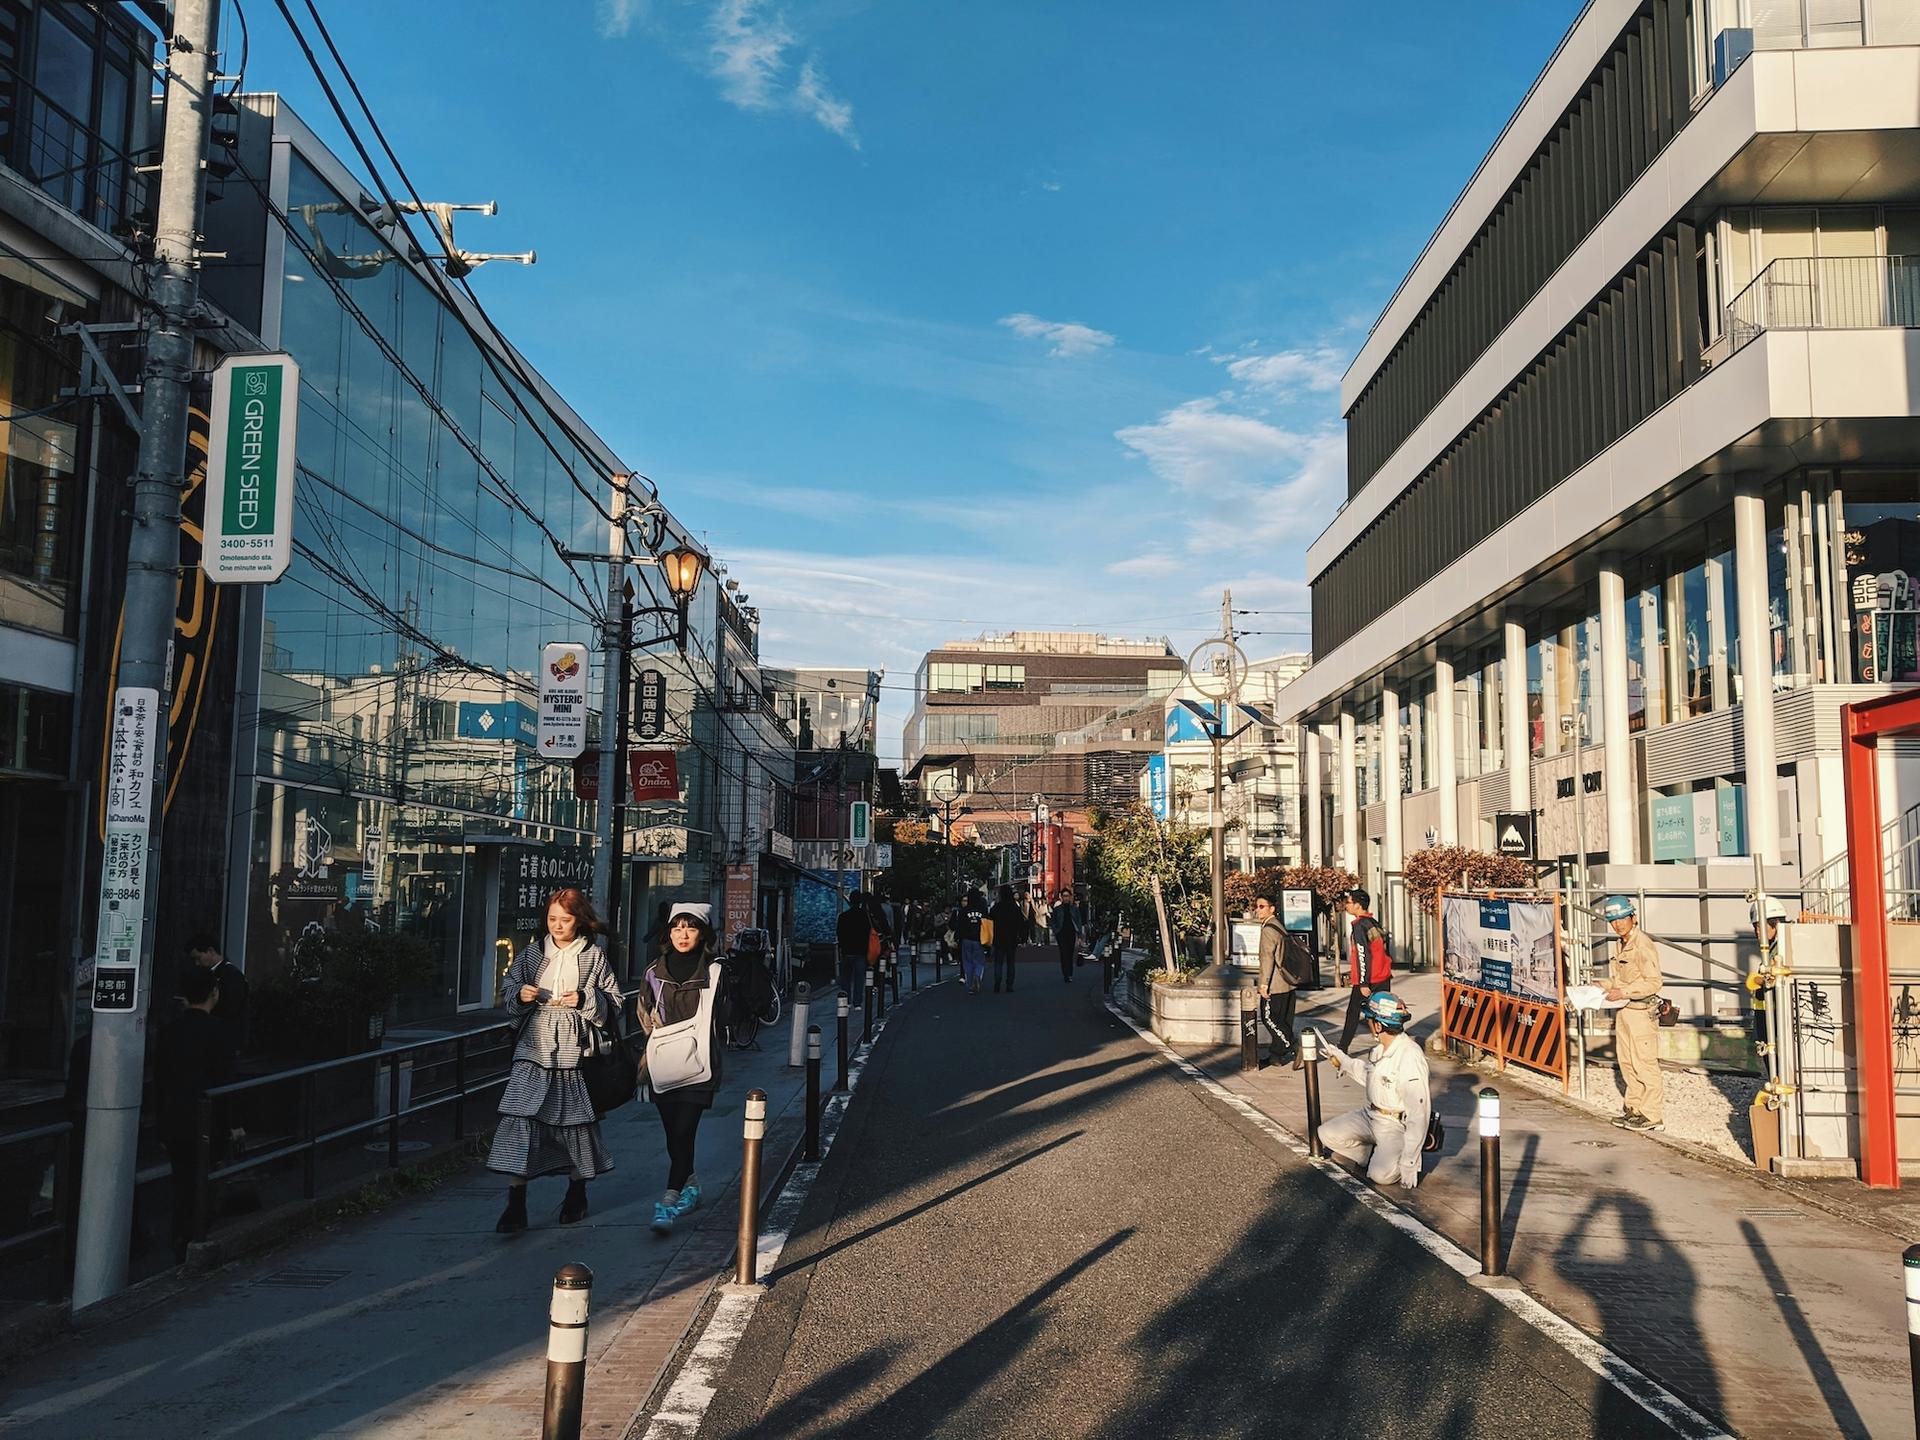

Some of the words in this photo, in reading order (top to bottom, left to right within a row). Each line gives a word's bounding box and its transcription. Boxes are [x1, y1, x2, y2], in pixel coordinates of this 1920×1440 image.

[241, 399, 264, 470] GREEN
[238, 474, 260, 530] SEED
[220, 539, 274, 549] 3400-5511
[543, 694, 583, 704] HYSTERIC
[553, 704, 572, 713] MINI
[1723, 831, 1733, 842] Go
[118, 832, 131, 879] ご来店の方
[129, 833, 142, 885] カンバン見て
[728, 910, 750, 920] BUY
[96, 991, 126, 1002] 6-14
